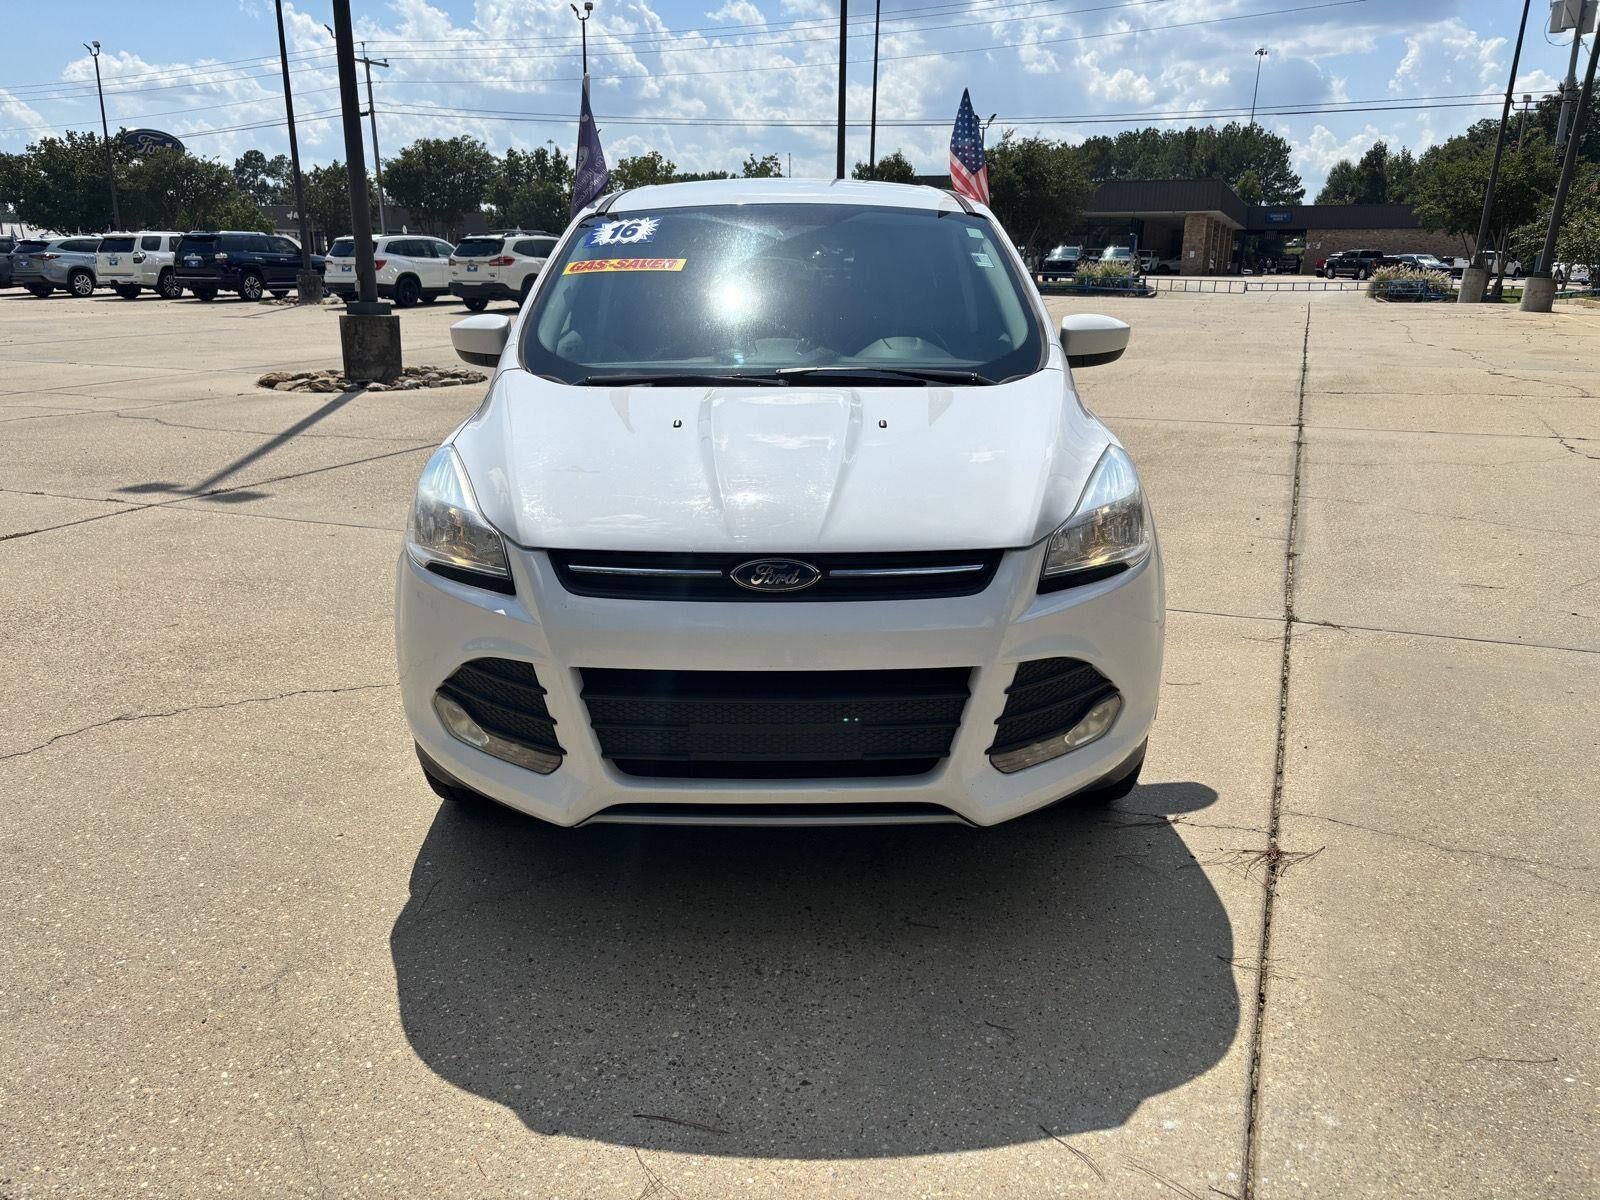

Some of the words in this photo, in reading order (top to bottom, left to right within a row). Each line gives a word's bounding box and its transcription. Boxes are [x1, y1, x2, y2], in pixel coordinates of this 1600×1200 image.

[138, 135, 170, 154] For
[609, 223, 642, 239] 16
[751, 564, 800, 584] Ford
